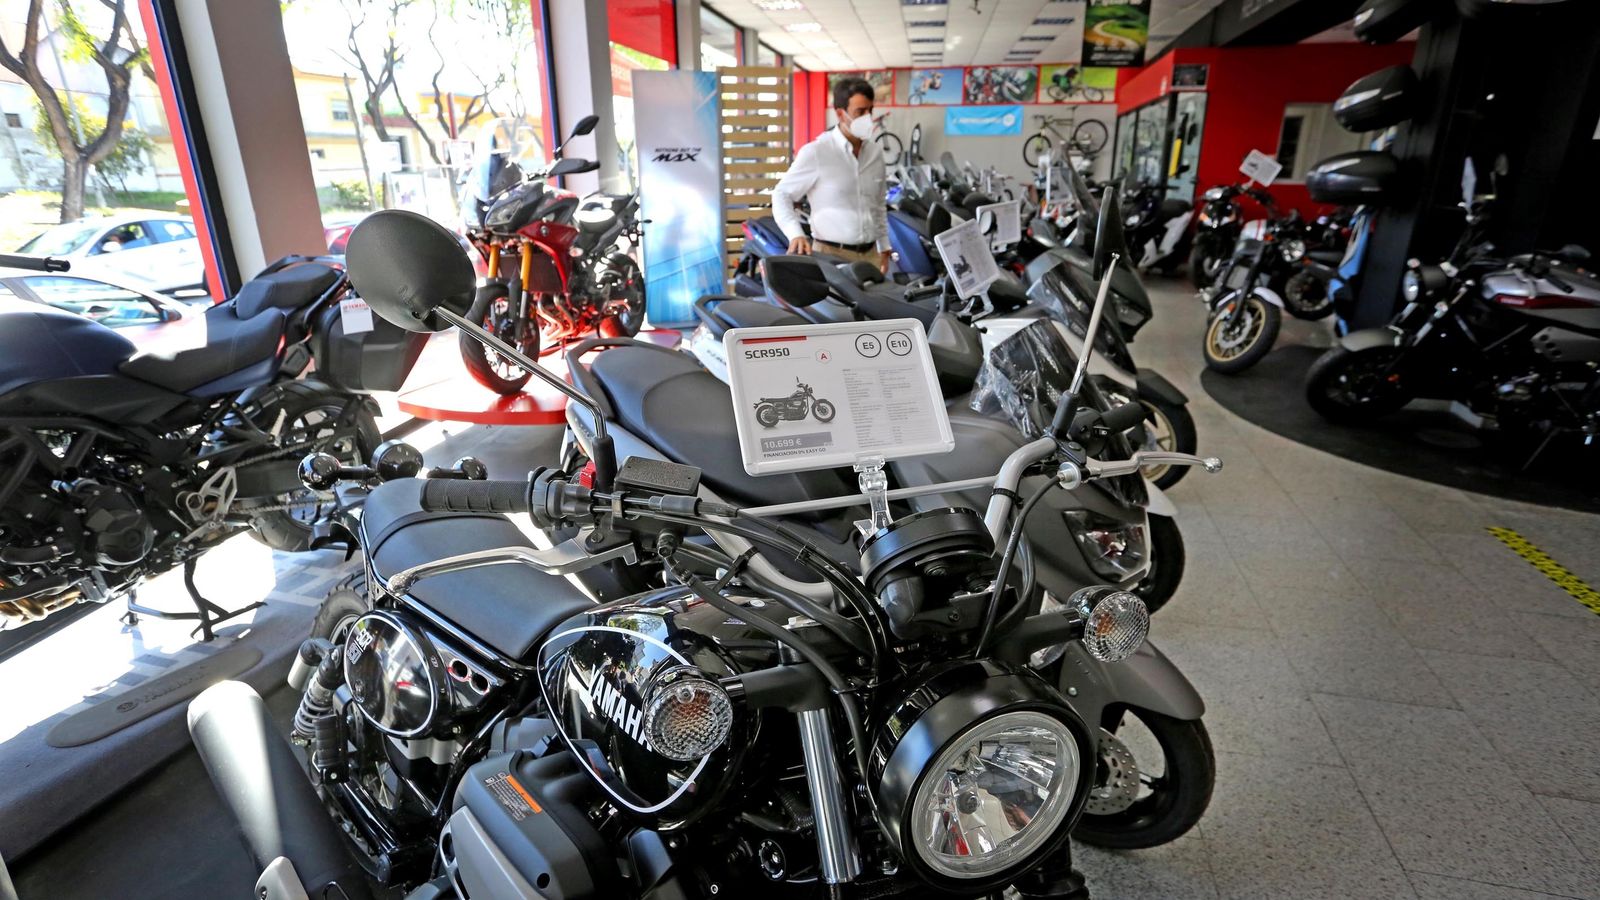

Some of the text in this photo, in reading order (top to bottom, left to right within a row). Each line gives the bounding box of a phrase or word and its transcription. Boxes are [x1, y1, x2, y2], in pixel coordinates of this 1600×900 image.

[652, 153, 699, 162] MAX
[862, 341, 875, 350] E5
[891, 340, 908, 348] E10
[745, 348, 790, 359] SCR950
[764, 438, 802, 449] 10.699 €
[356, 628, 373, 650] SCR
